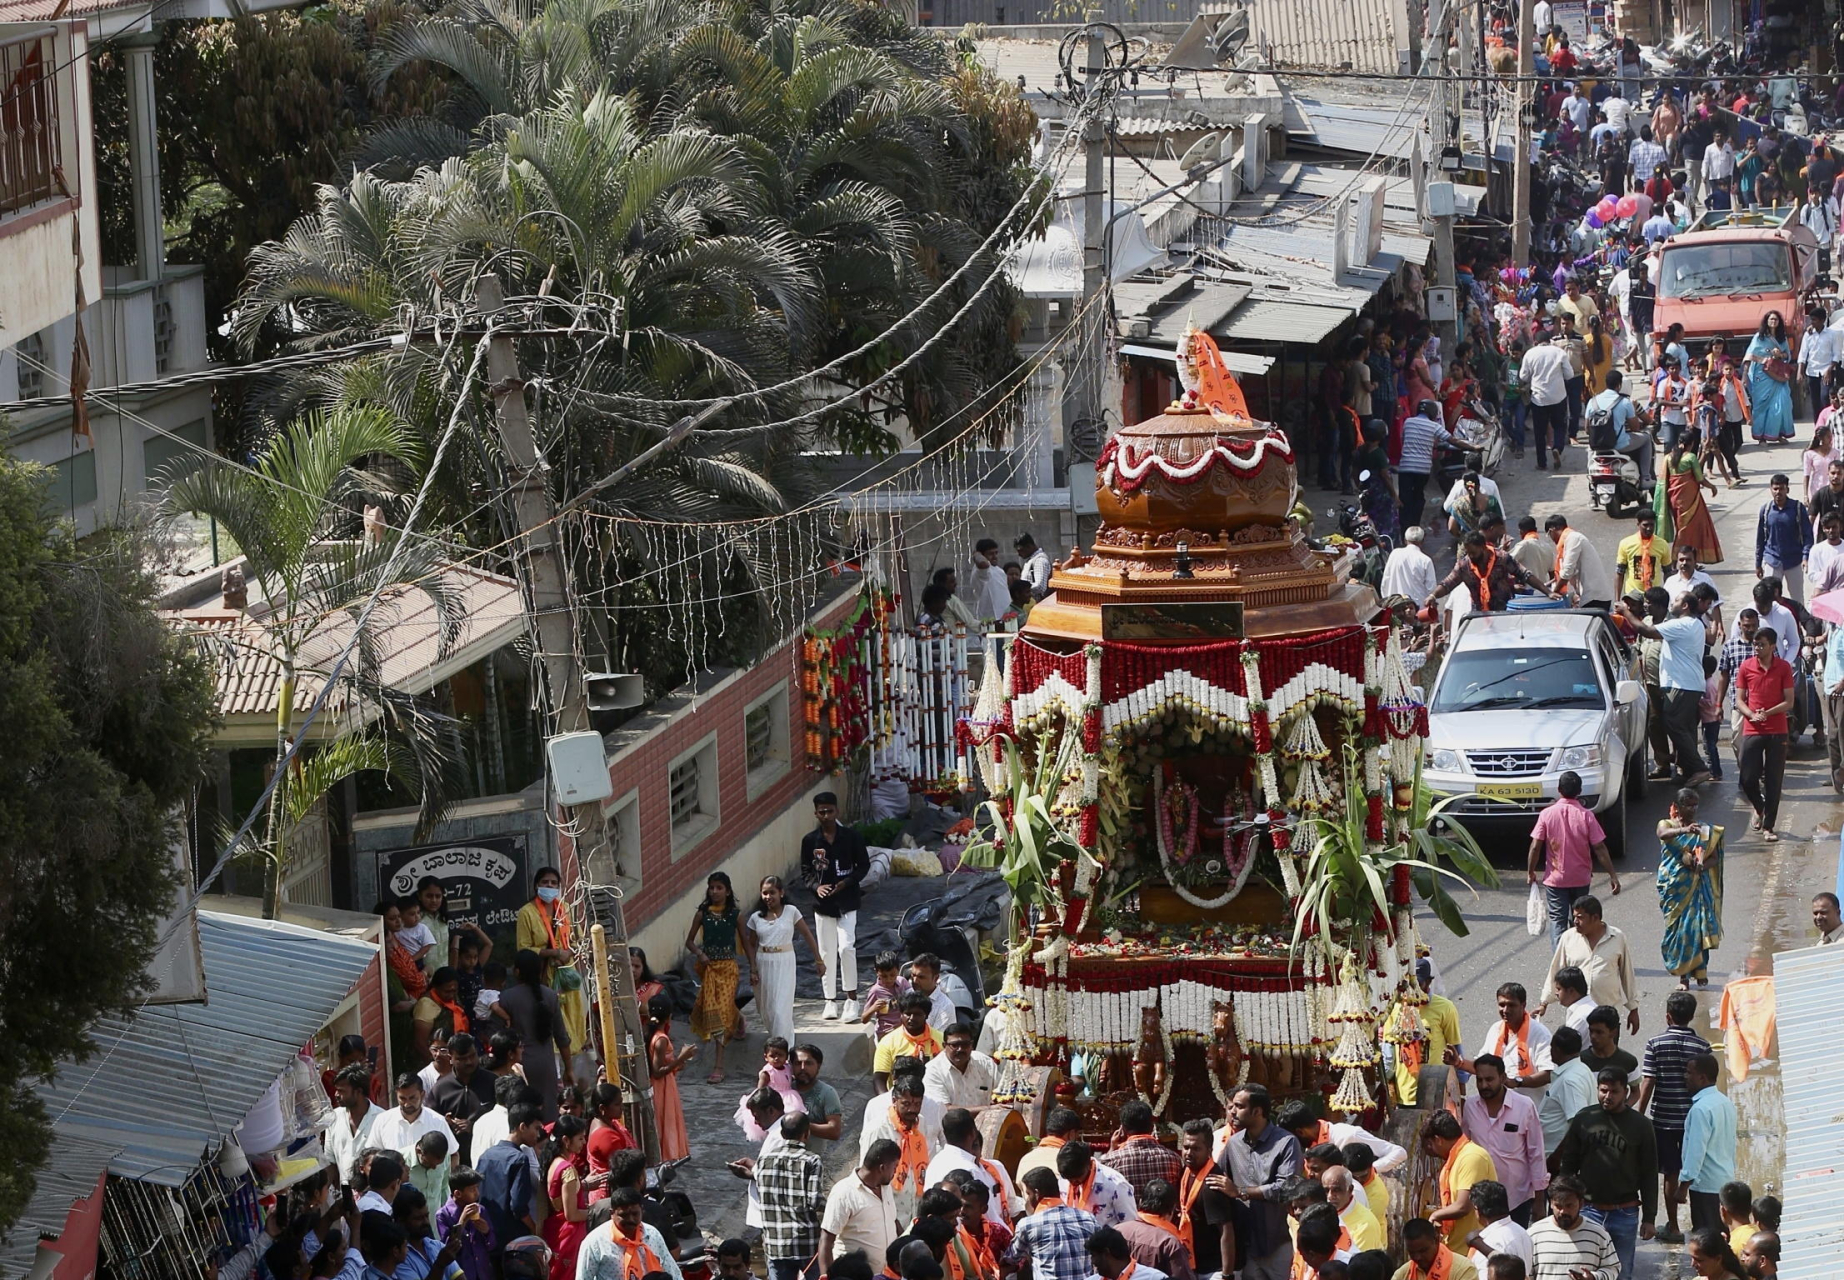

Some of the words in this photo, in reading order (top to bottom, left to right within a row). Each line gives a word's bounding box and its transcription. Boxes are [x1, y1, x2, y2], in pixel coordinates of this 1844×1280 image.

[1515, 787, 1540, 795] 5130
[395, 866, 421, 893] ಶ್ರೀ
[423, 852, 482, 872] ಬಾಲಾಜಿ
